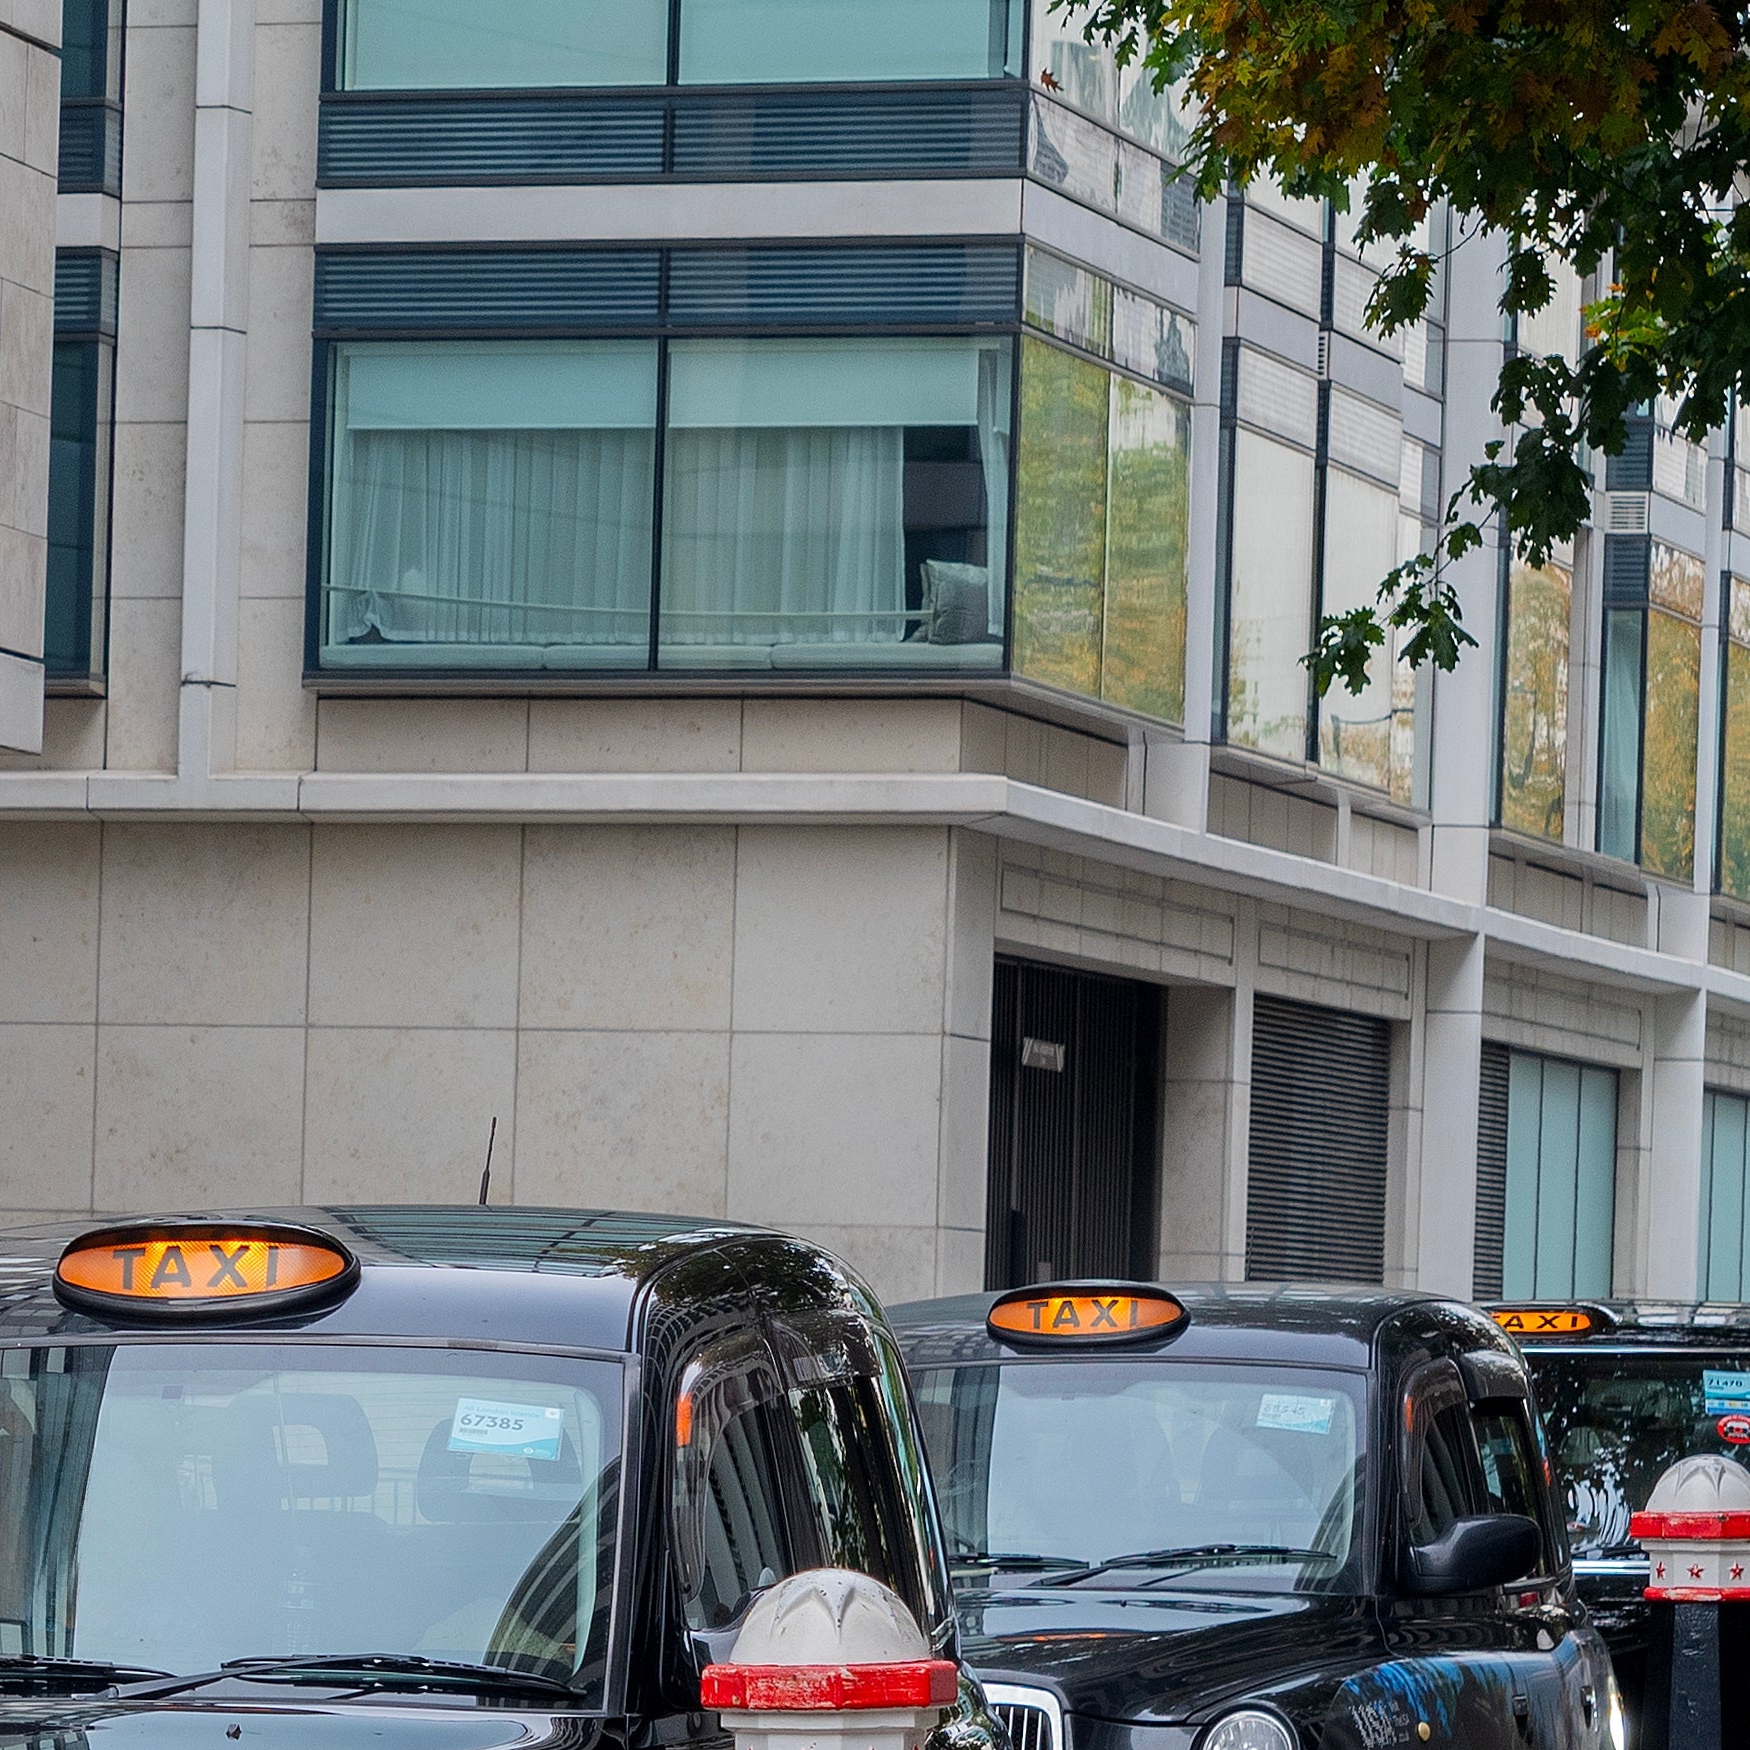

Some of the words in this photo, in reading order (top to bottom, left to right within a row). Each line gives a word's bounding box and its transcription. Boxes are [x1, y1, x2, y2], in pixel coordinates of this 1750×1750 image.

[112, 1244, 280, 1291] TAXI
[1026, 1300, 1139, 1330] TAXI
[1493, 1315, 1578, 1330] AXI
[460, 1413, 524, 1431] 67385
